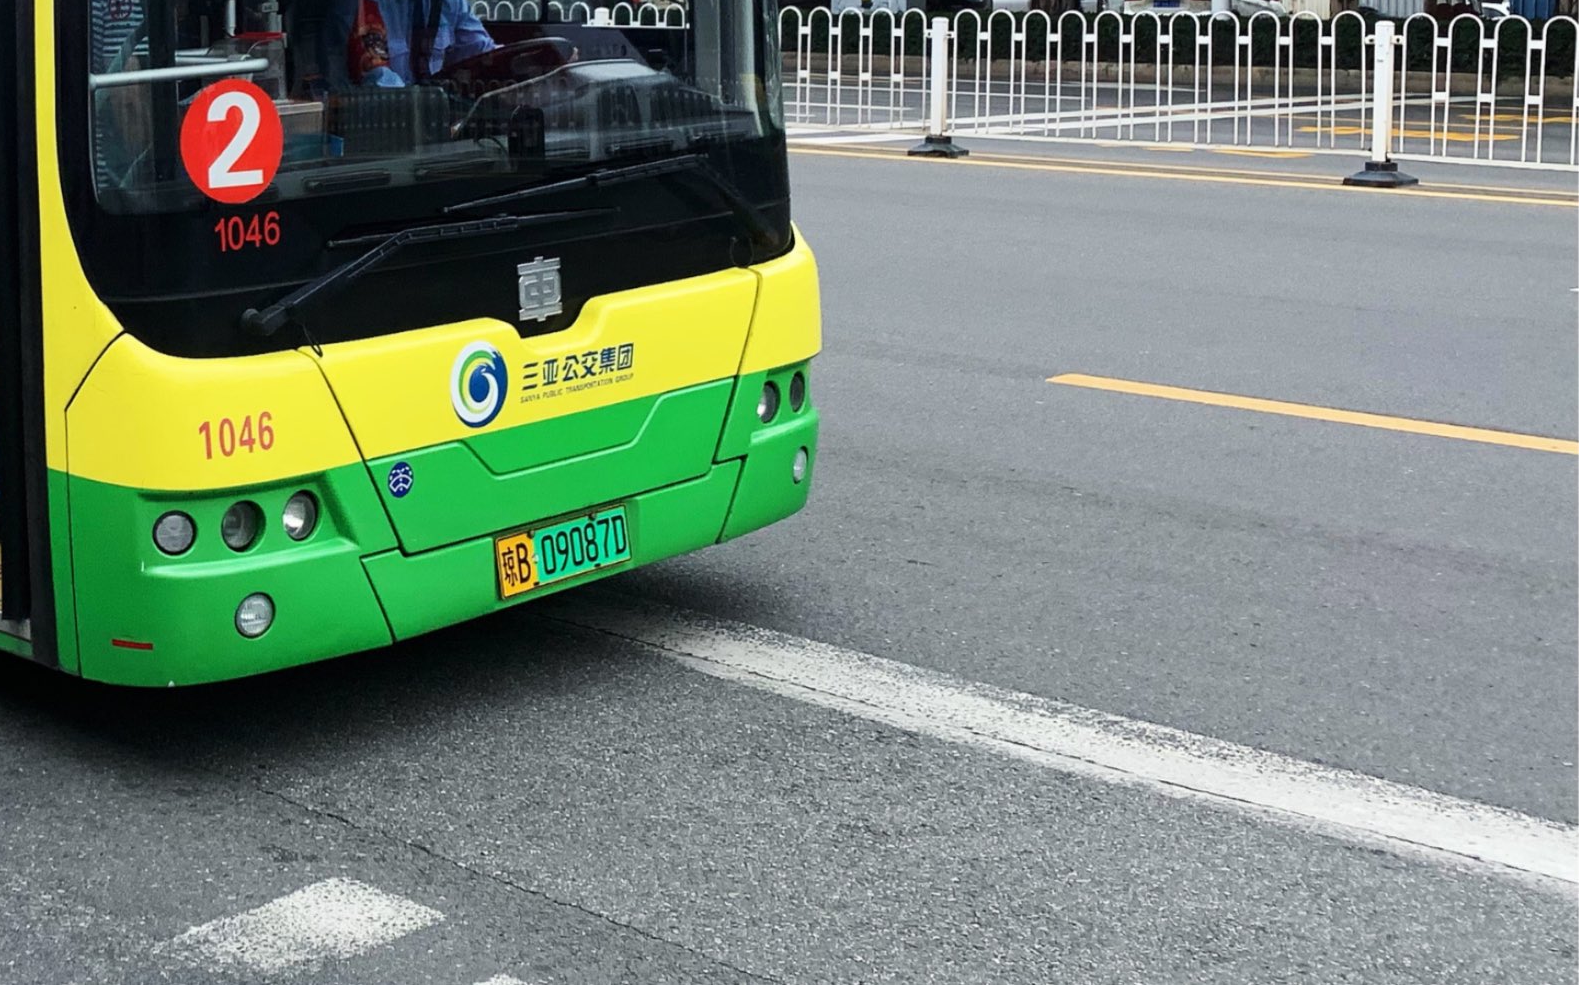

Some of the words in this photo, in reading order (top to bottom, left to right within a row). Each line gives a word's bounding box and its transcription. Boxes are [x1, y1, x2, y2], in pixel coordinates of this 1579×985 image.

[206, 91, 264, 189] 2
[214, 211, 281, 253] 1046
[522, 342, 635, 391] 三亚公交集团
[198, 410, 275, 461] 1046
